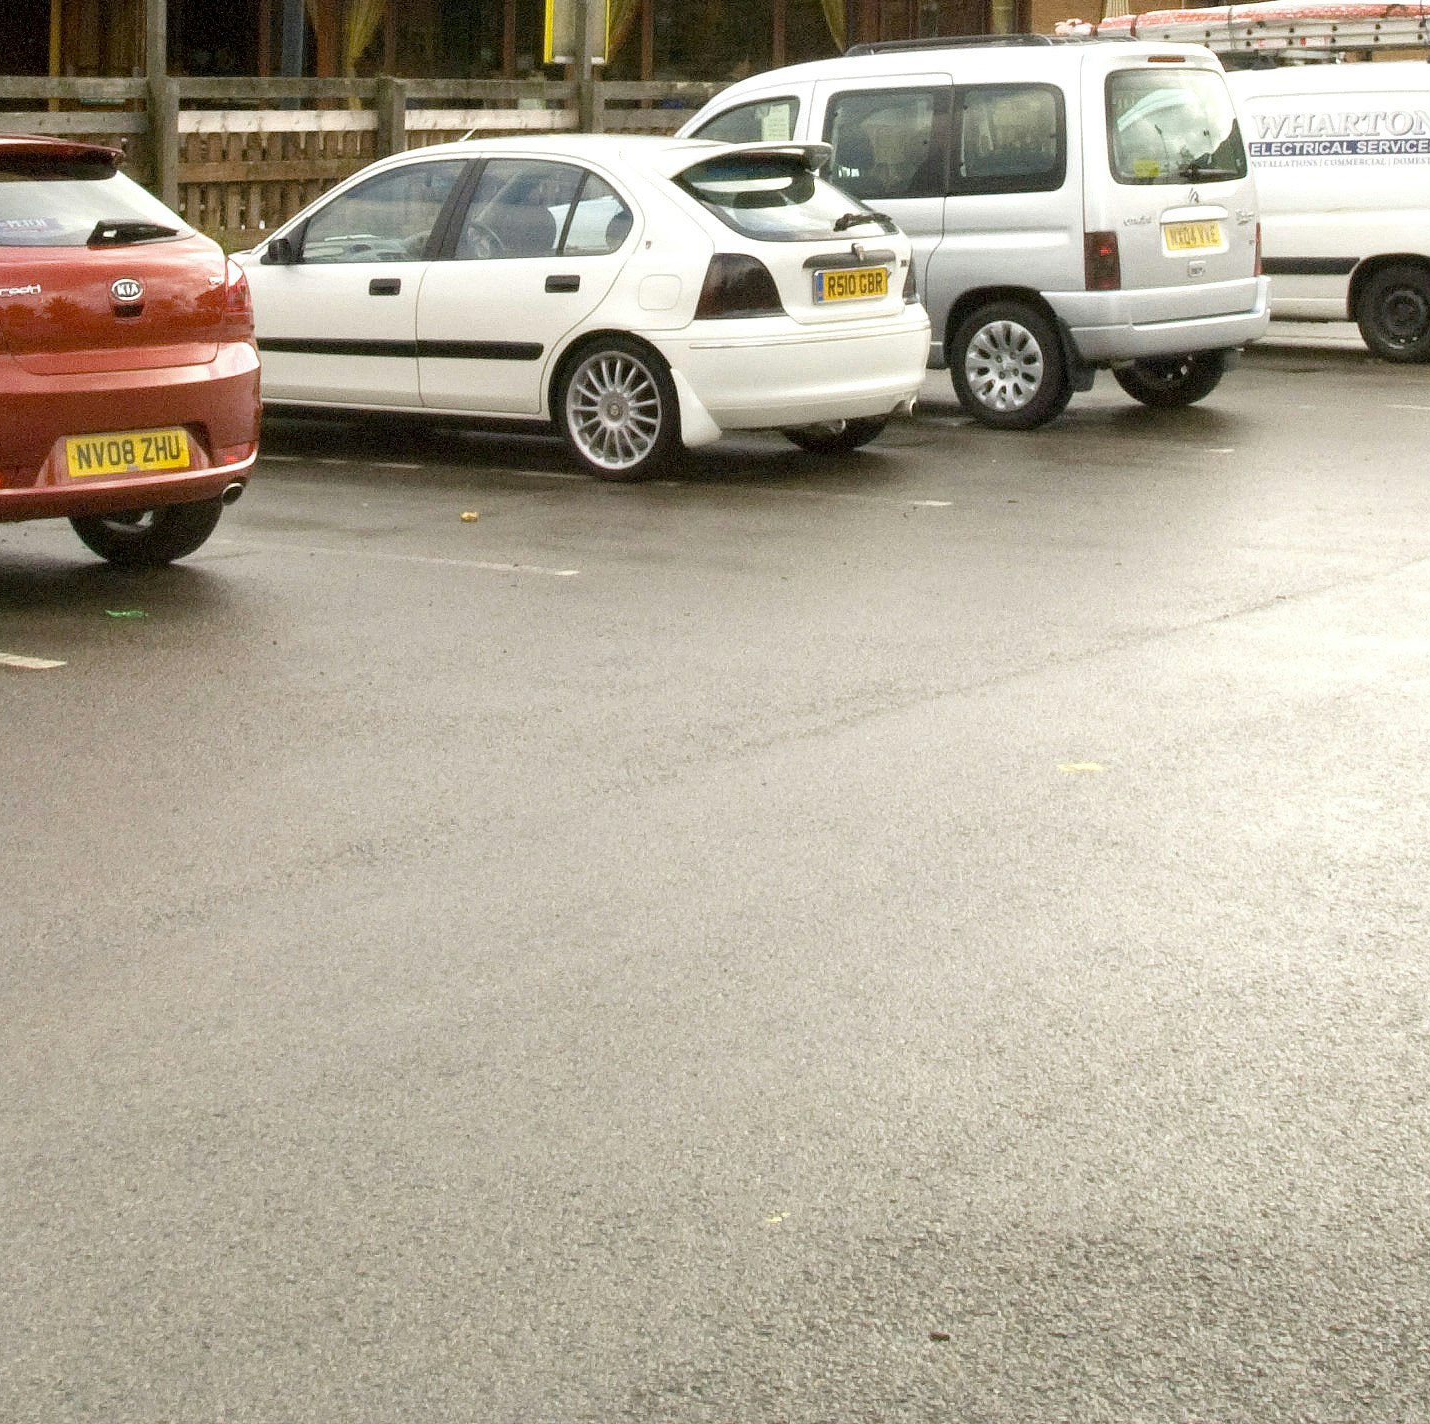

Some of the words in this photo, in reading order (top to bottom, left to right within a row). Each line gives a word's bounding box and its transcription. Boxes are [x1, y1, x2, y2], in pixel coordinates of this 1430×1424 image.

[1250, 140, 1353, 156] ELECTRICAL
[1251, 158, 1318, 168] NSTALLATIONS
[1324, 157, 1386, 167] COMMERCIAL
[116, 282, 139, 296] KIA
[76, 439, 136, 469] NV08
[141, 435, 180, 463] ZHU
